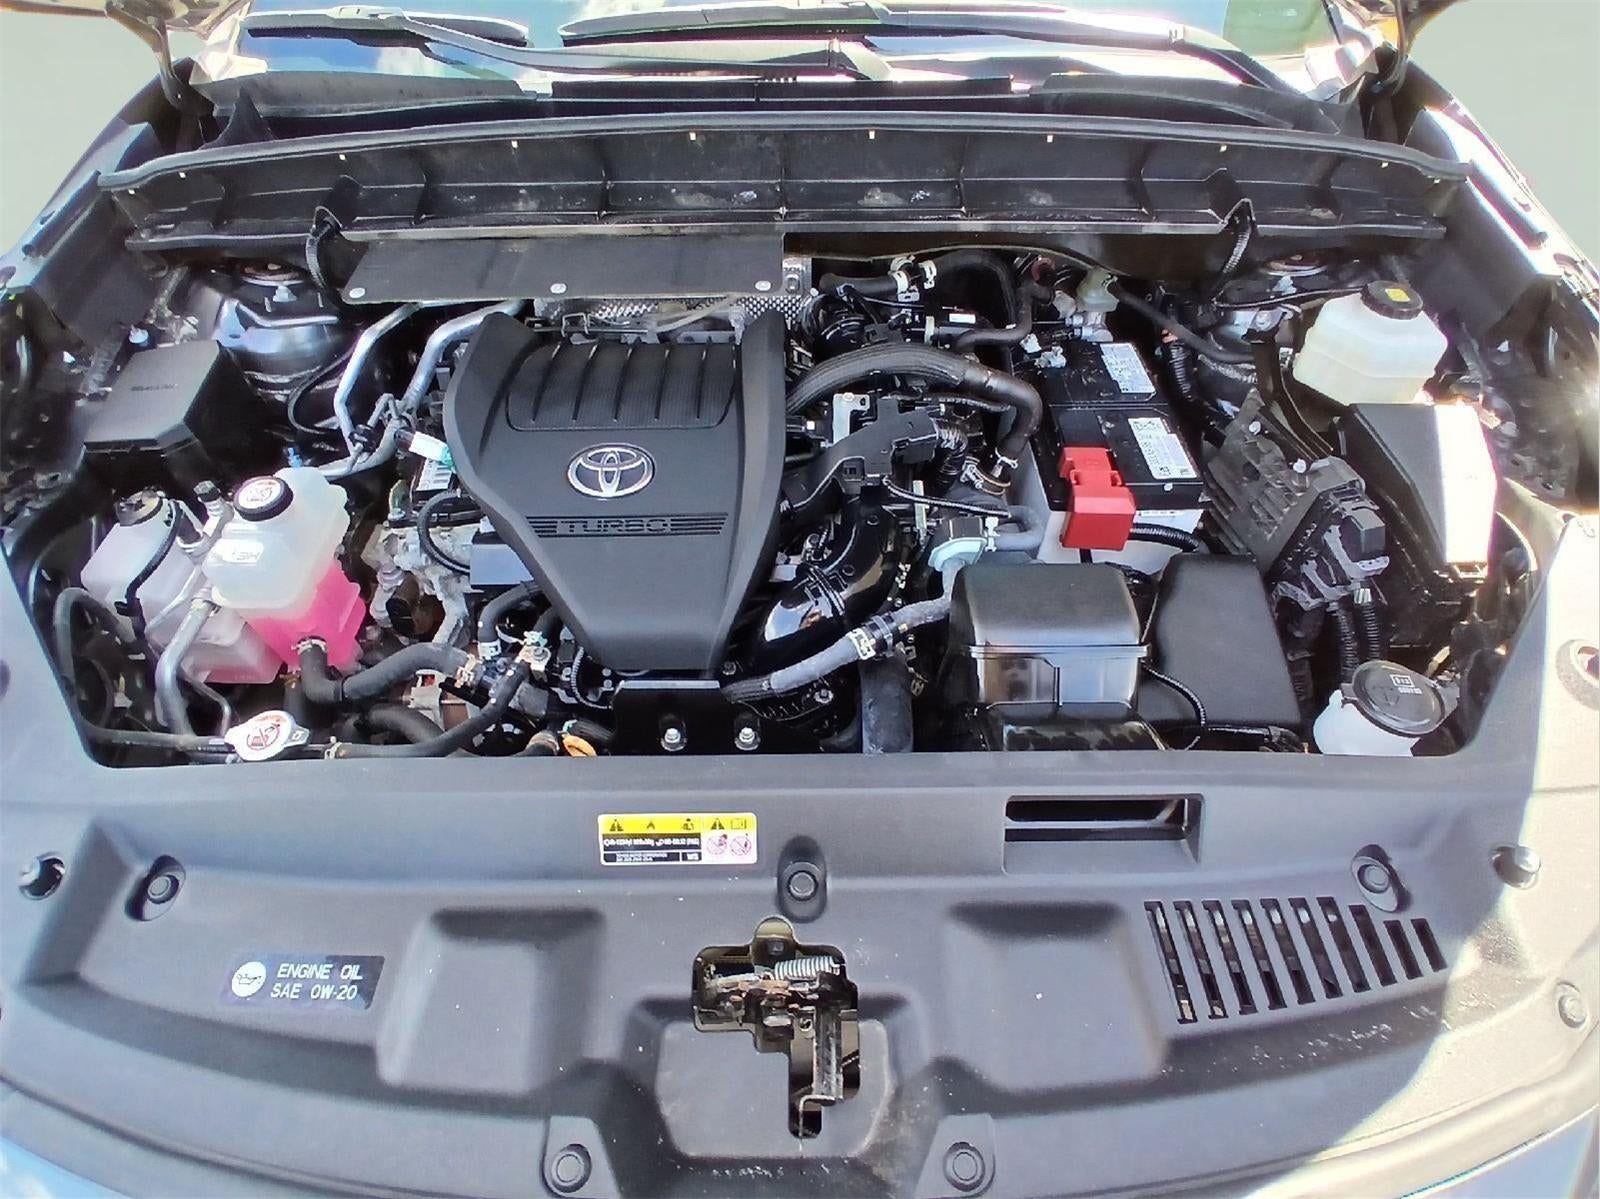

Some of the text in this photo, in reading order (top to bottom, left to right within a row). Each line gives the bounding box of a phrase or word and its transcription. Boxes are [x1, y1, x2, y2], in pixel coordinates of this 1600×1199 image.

[560, 518, 668, 533] TURBO
[276, 963, 364, 981] ENGINE OIL
[270, 982, 303, 999] SAE
